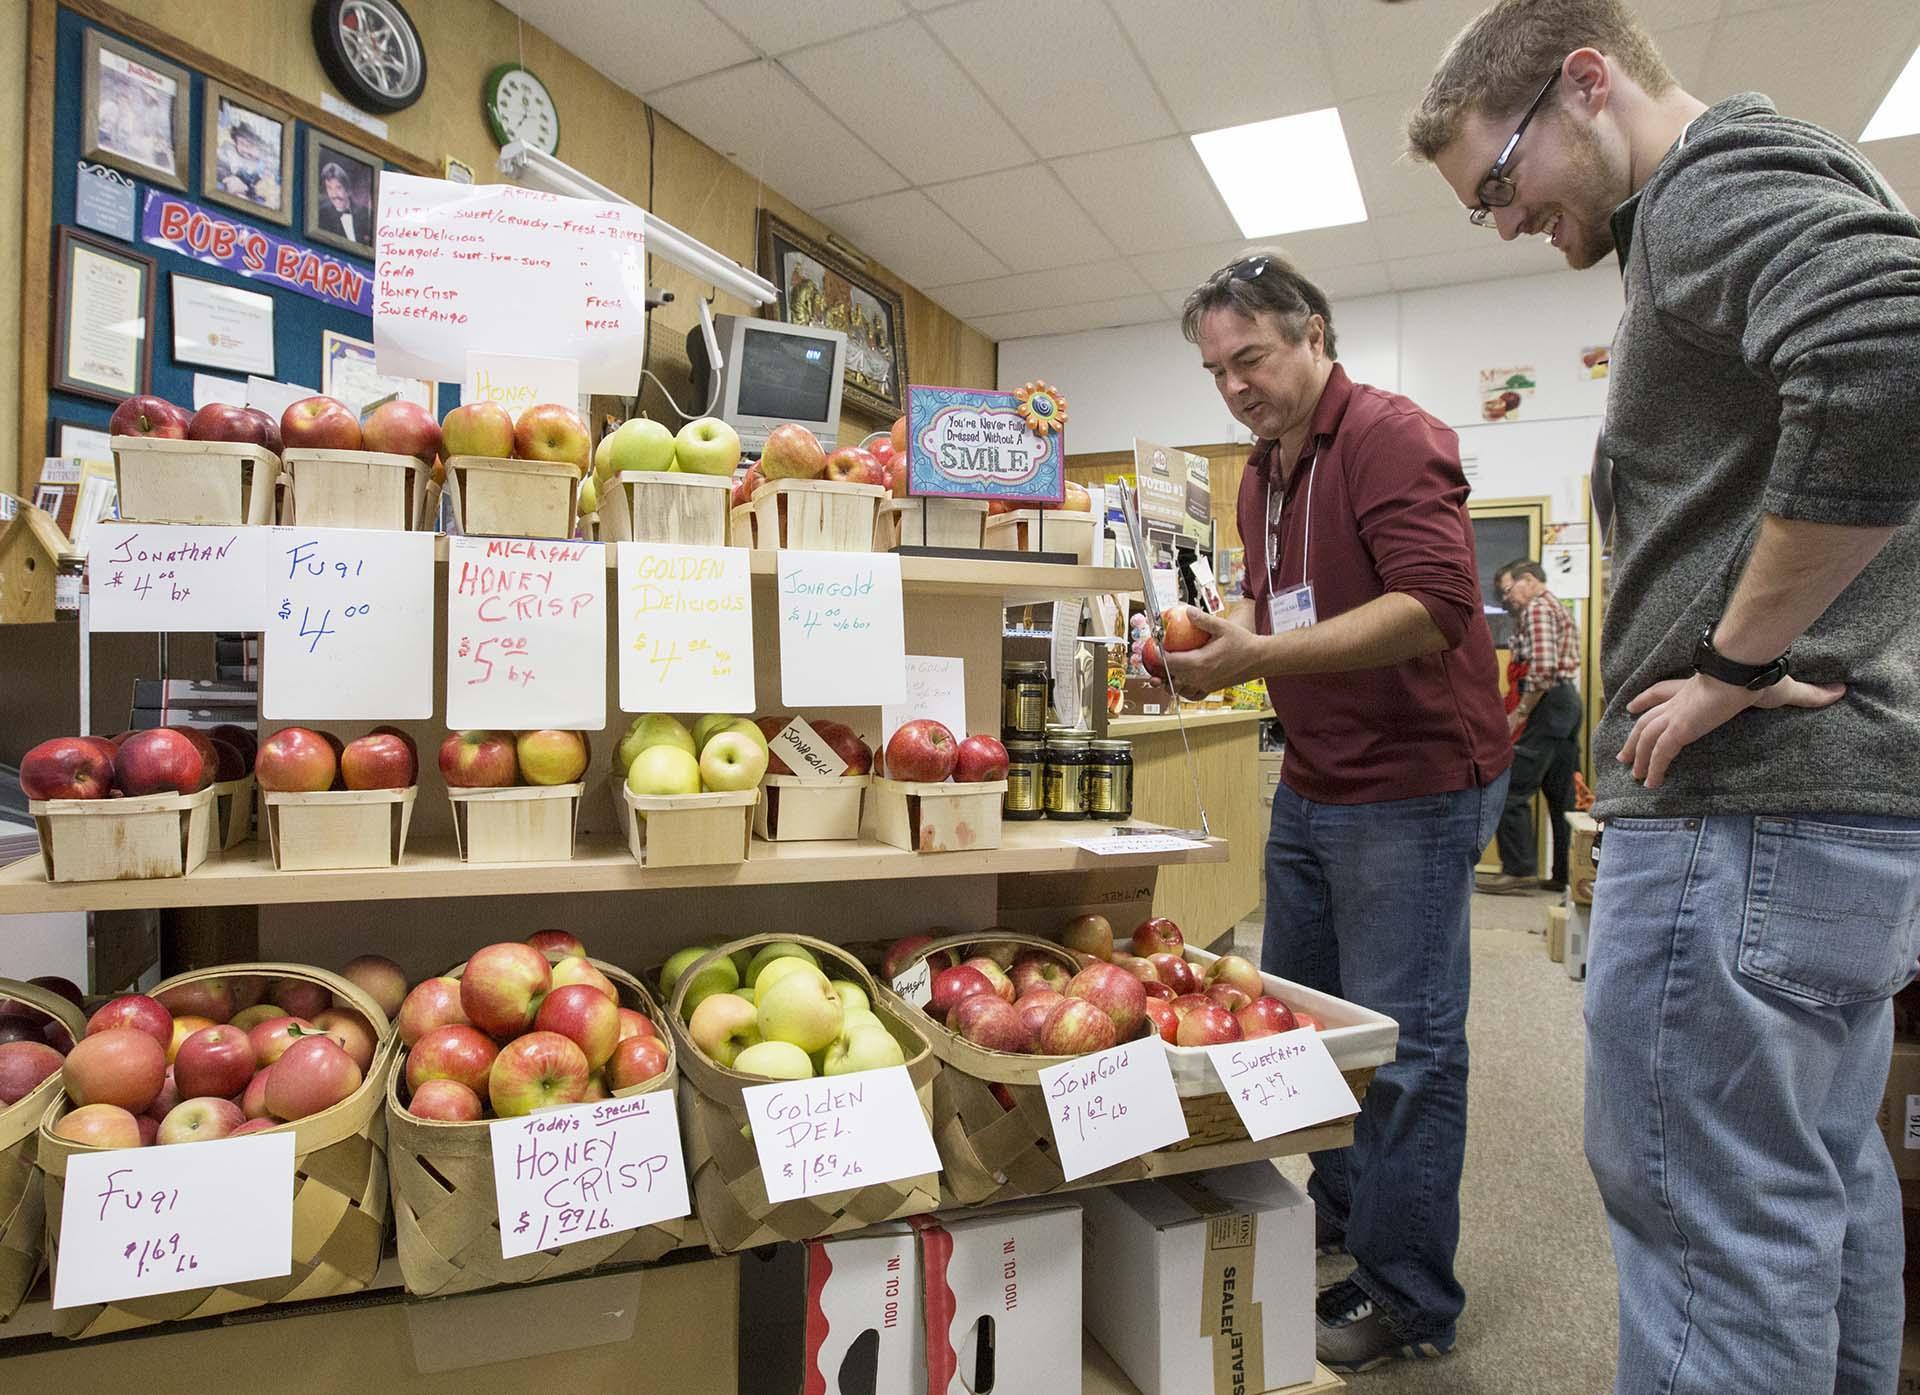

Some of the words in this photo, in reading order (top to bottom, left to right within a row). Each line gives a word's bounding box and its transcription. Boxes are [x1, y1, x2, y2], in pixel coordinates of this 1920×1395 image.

[160, 202, 268, 272] BOB'S
[275, 244, 364, 306] BARN
[947, 430, 980, 442] Dressed
[983, 430, 1014, 444] Without
[1016, 434, 1023, 445] A
[948, 415, 977, 430] You're
[980, 417, 1007, 430] Never
[1008, 421, 1026, 434] Fully
[940, 443, 1028, 472] SMILE
[458, 562, 552, 596] HONEY
[478, 593, 594, 622] CRISP
[516, 1131, 617, 1181] HONEY
[543, 1154, 669, 1209] CRISP
[1005, 1284, 1017, 1313] 1100
[883, 1302, 898, 1329] 1100
